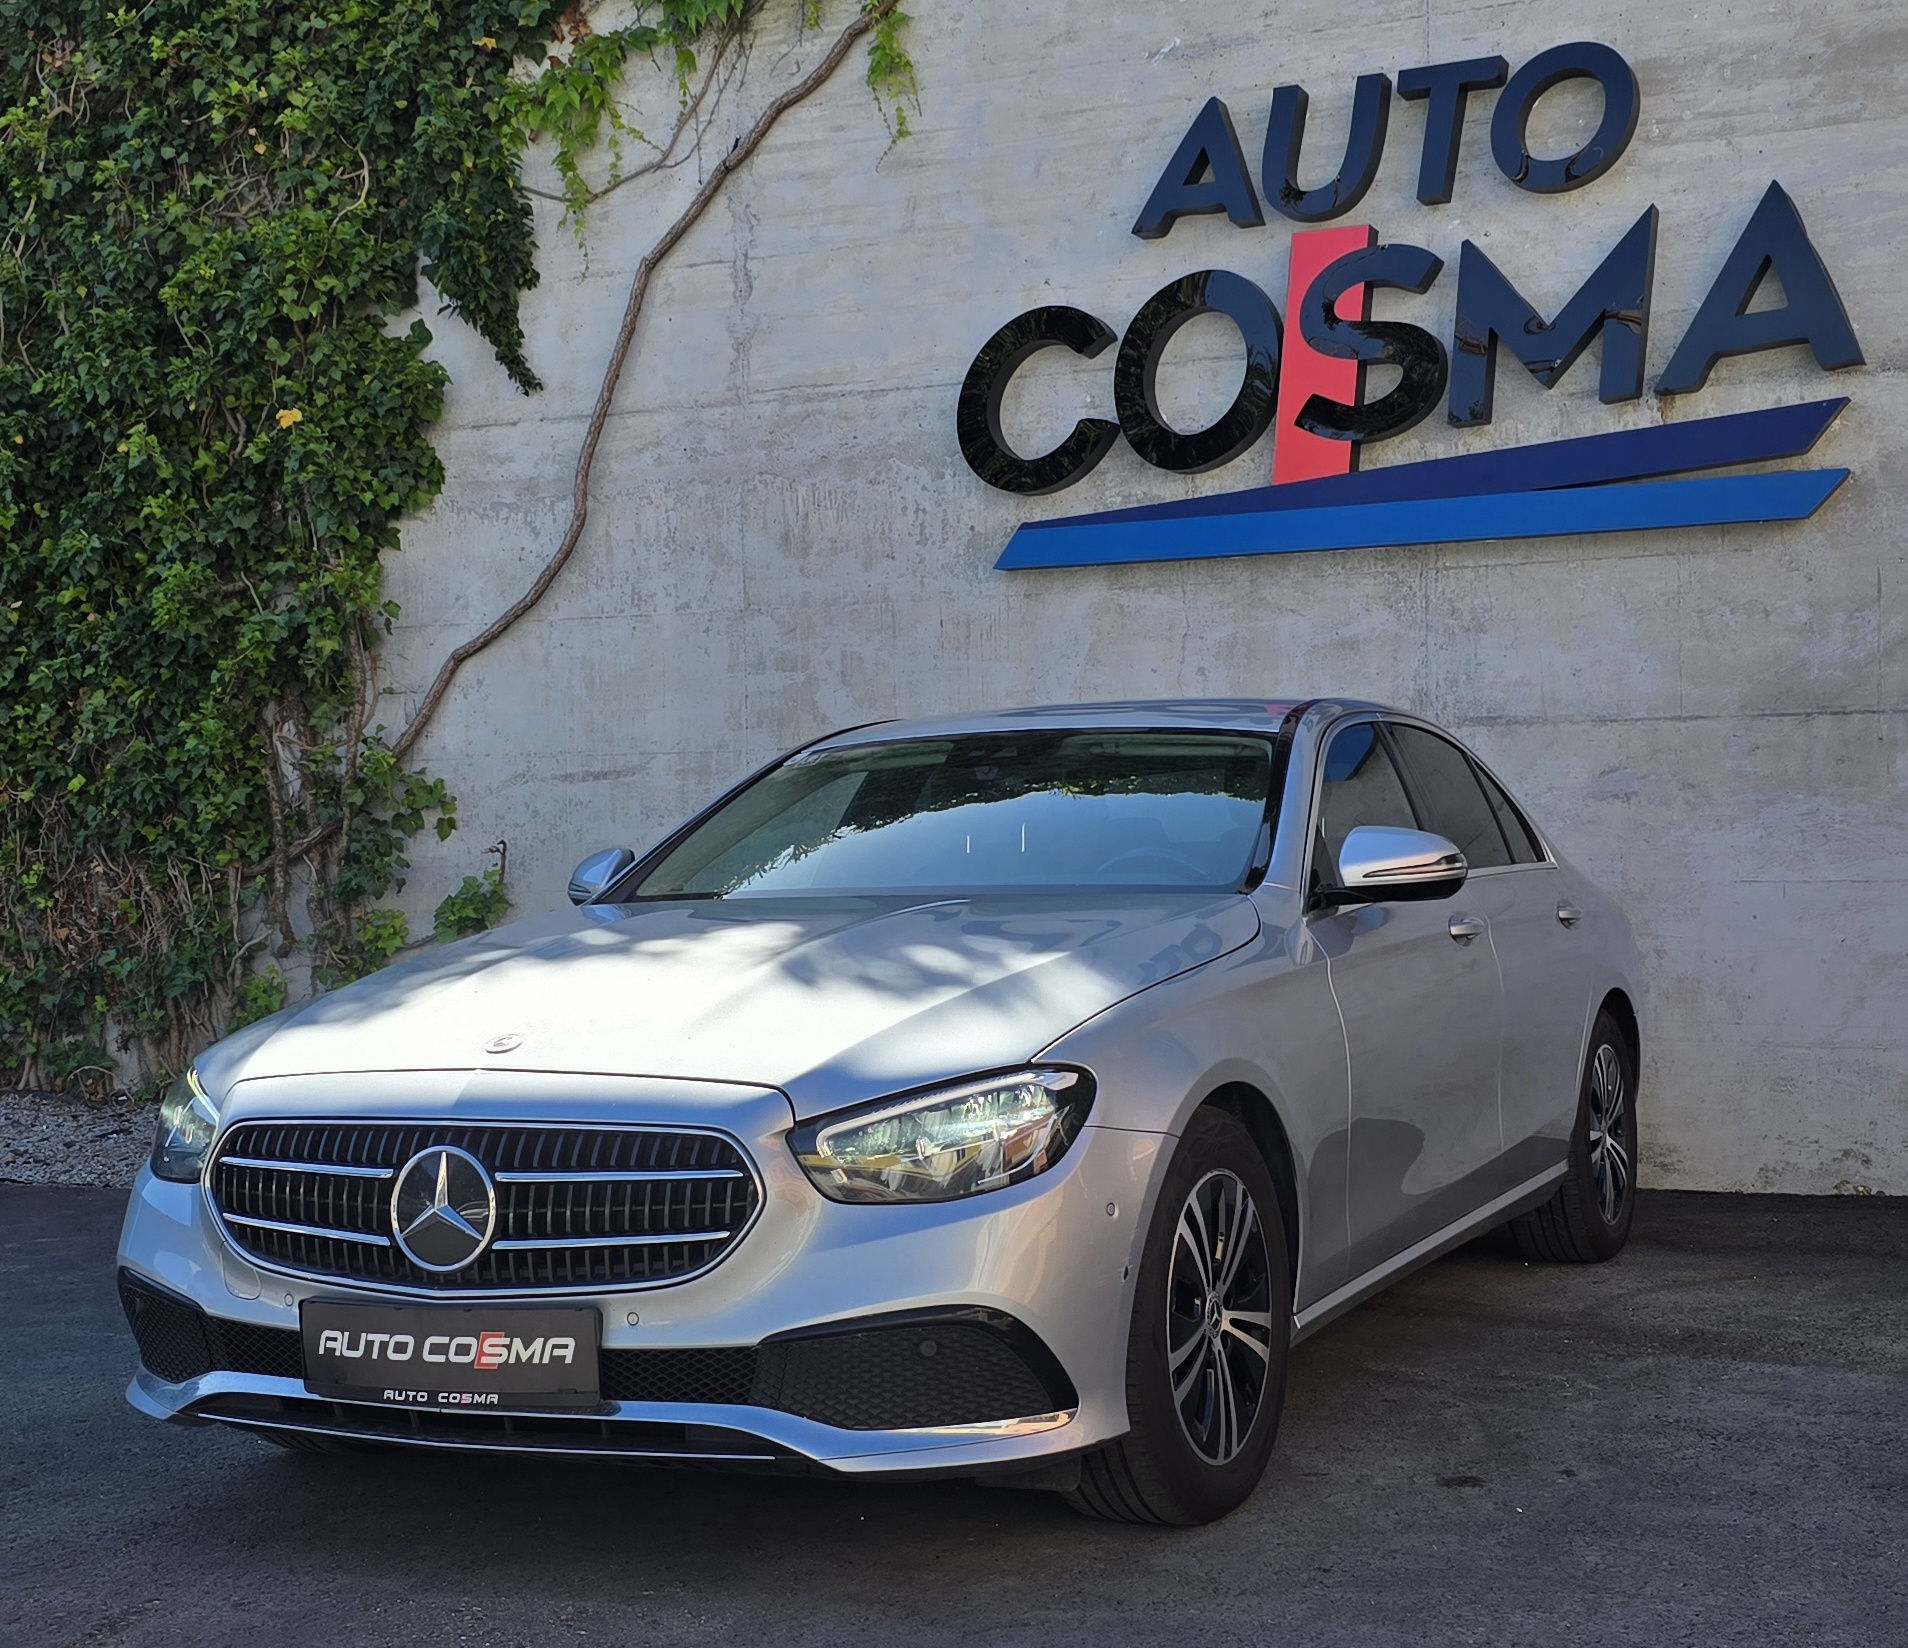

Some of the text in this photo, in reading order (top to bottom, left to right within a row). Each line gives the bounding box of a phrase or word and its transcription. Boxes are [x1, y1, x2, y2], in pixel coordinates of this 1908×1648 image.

[1132, 42, 1641, 239] AUTO
[957, 181, 1866, 496] COSMA
[318, 1329, 576, 1365] AUTO COSMA
[383, 1390, 499, 1405] AUTO COSMA
